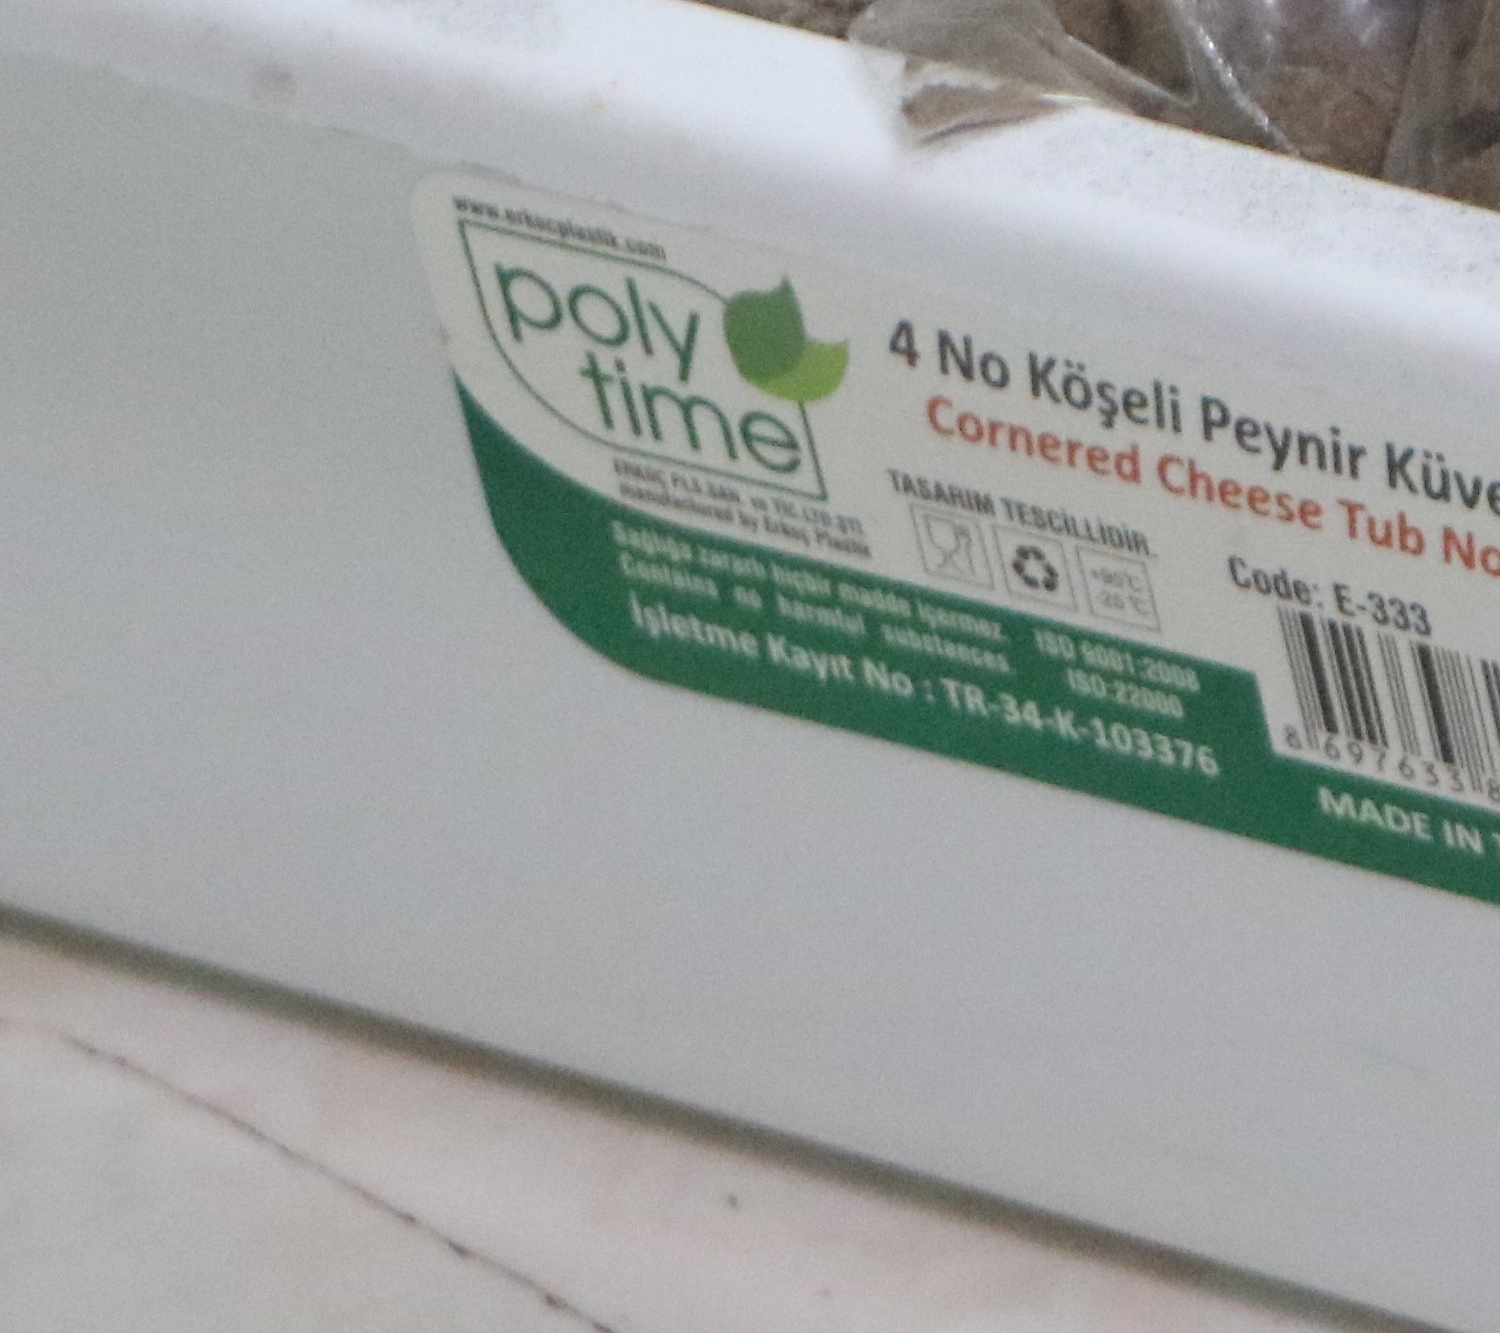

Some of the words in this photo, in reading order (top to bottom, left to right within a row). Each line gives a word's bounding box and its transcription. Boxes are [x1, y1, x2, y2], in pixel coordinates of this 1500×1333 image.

[494, 263, 699, 384] poly
[579, 351, 800, 474] time
[888, 320, 919, 367] 4
[937, 330, 1010, 390] No
[1027, 352, 1181, 434] Köşeli
[1200, 395, 1366, 479] Peynir
[889, 470, 994, 515] TASARIM
[926, 395, 1140, 484] Cornered
[1156, 454, 1320, 530] Cheese
[1337, 499, 1425, 556] Tub
[1227, 556, 1321, 606] Code:
[1332, 582, 1431, 637] E-333
[1318, 787, 1431, 840] MADE
[1443, 821, 1483, 854] IN
